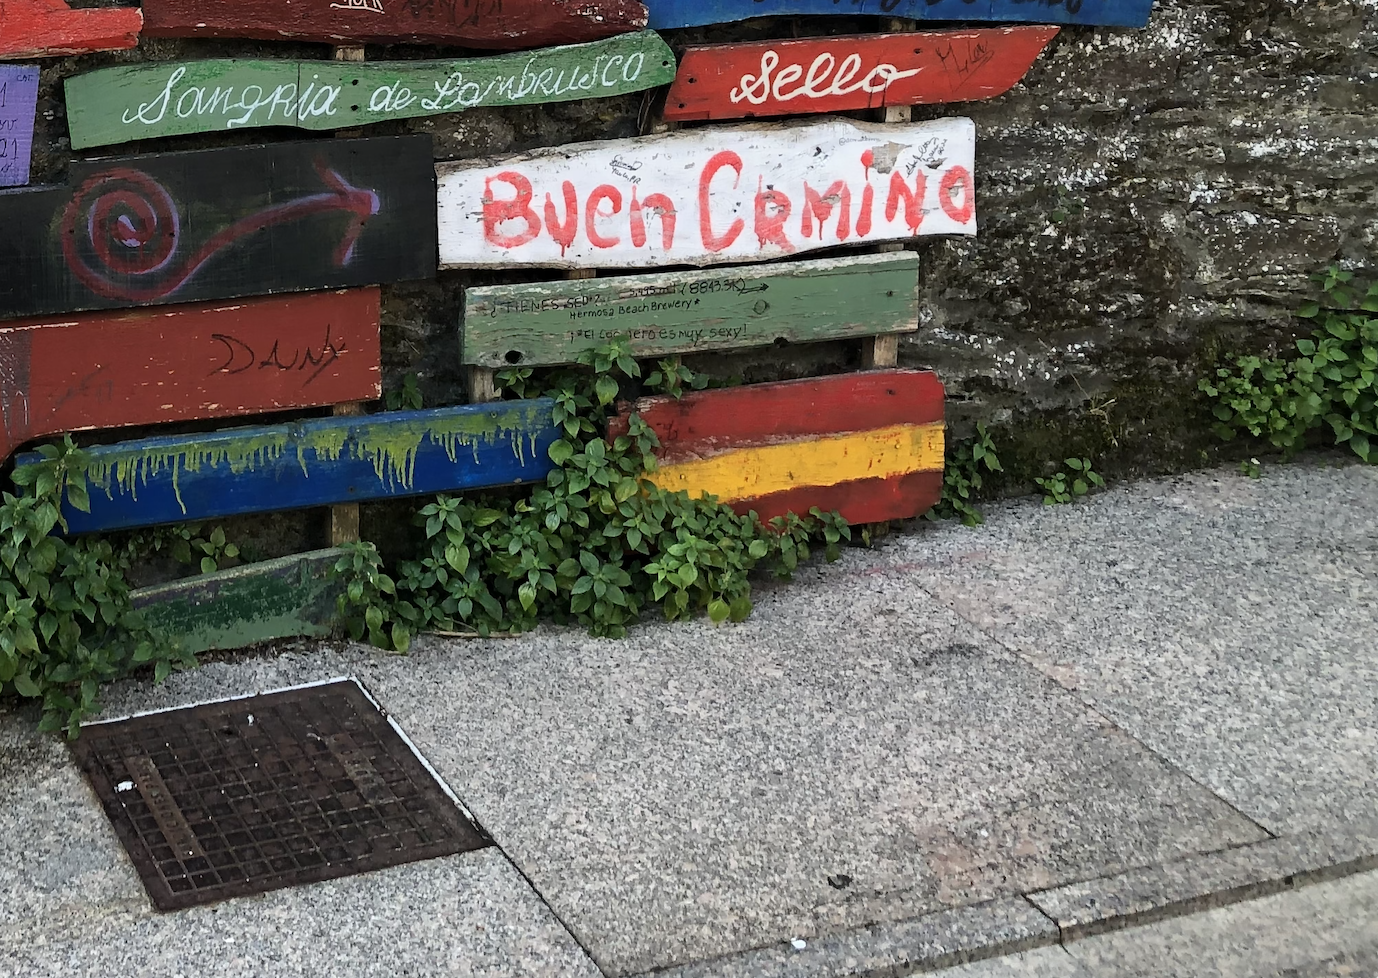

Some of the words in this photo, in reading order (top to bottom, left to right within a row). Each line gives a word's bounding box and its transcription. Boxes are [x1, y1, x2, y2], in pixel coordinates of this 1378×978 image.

[729, 49, 926, 105] Sello
[367, 79, 419, 113] de
[569, 307, 615, 320] Hermosa
[618, 303, 649, 315] Beach
